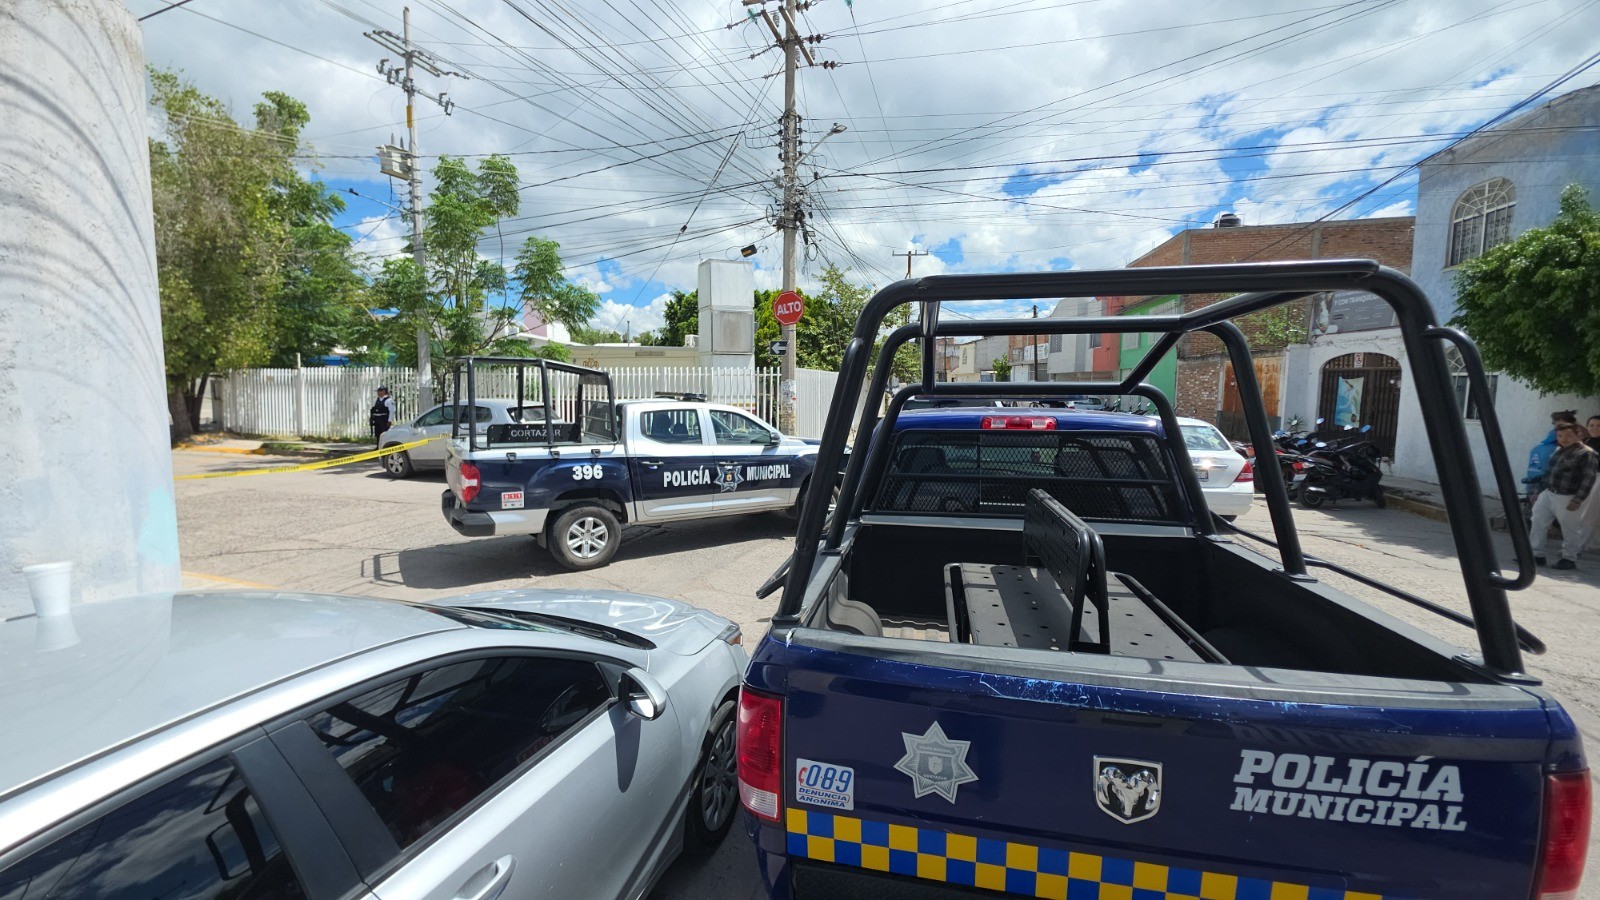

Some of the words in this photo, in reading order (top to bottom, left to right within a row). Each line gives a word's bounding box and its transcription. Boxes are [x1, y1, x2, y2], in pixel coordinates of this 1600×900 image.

[777, 301, 801, 316] ALTO
[511, 429, 561, 437] CORTAZR
[572, 464, 603, 481] 396
[664, 465, 711, 488] POLICÍA
[747, 464, 791, 482] MUNICIPAL
[1233, 749, 1465, 802] POLICÍA
[799, 787, 847, 802] DENUNCIA
[1230, 786, 1468, 832] MUNICIPAL
